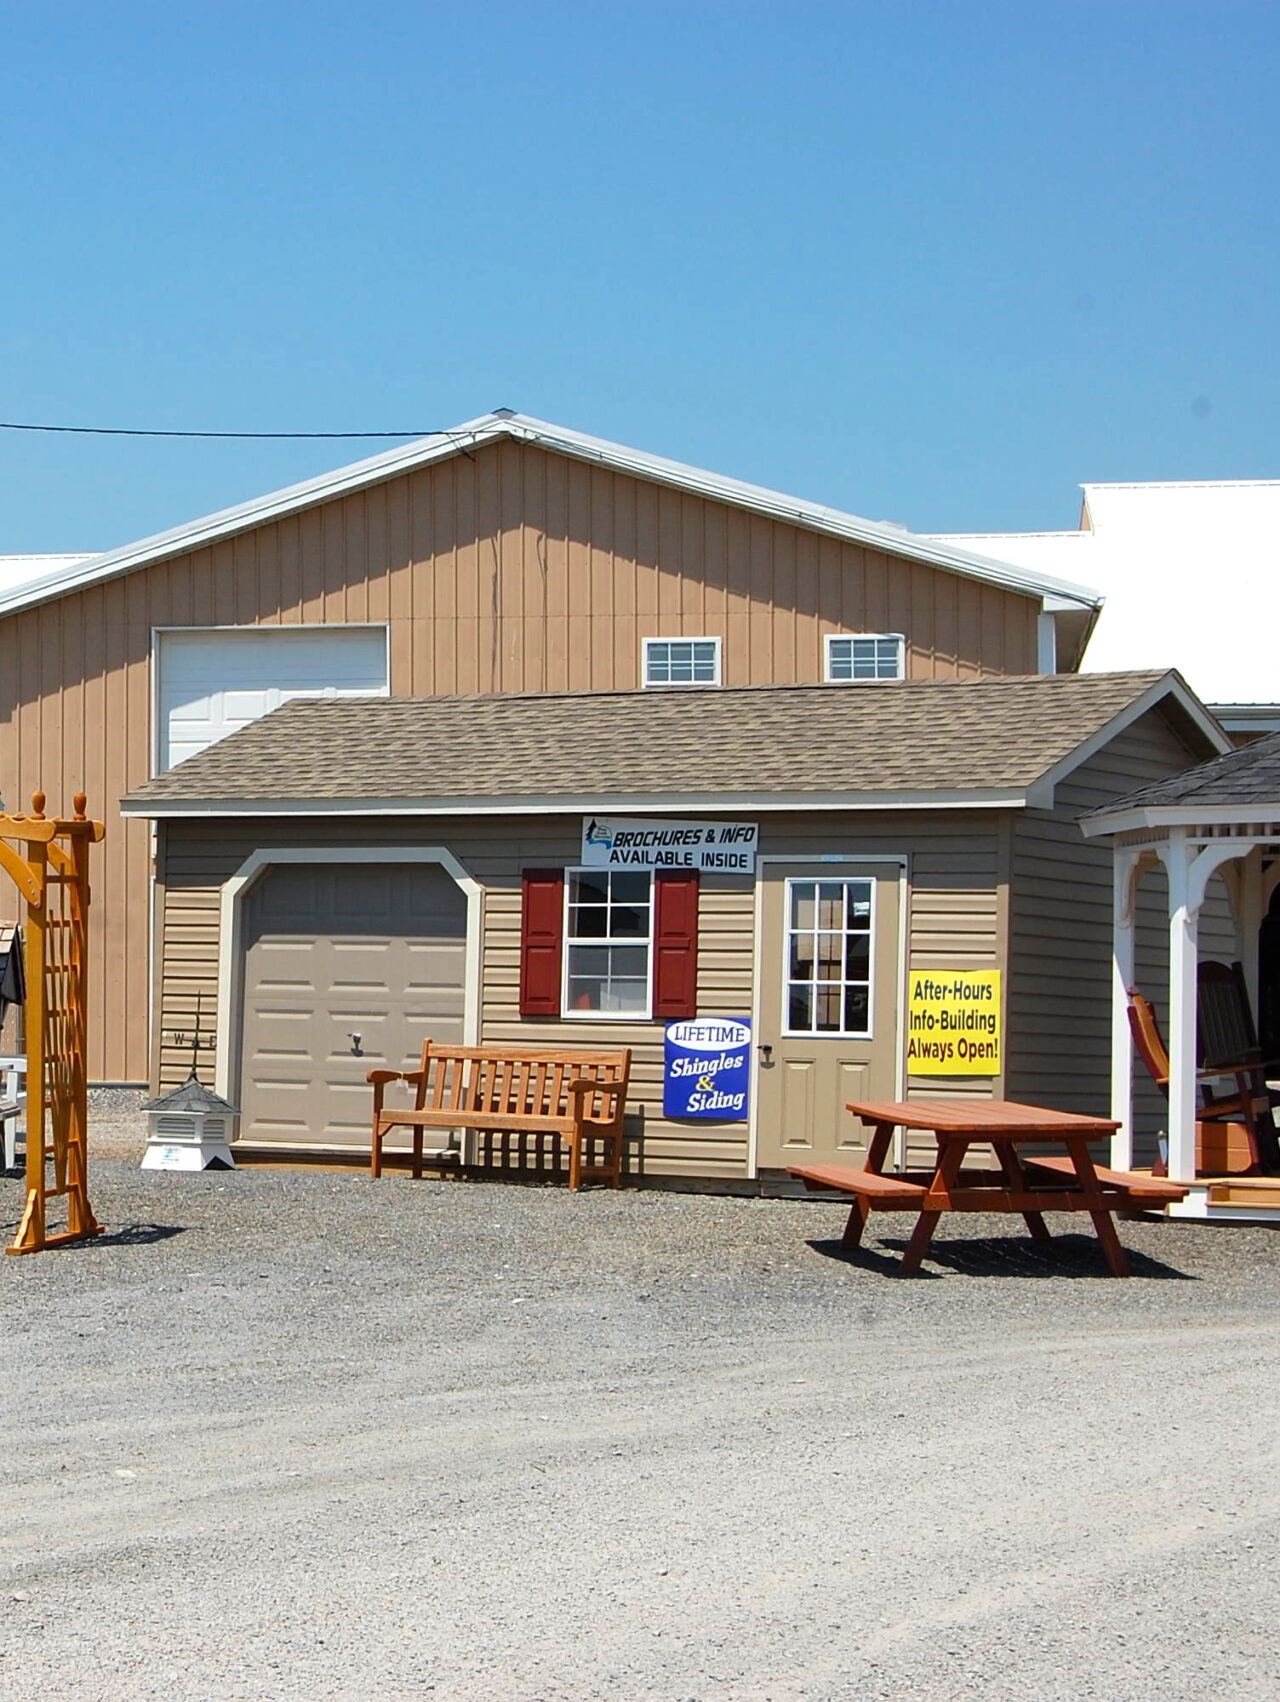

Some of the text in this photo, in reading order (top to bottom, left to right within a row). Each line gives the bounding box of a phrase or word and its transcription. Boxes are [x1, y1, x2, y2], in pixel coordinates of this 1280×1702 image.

[613, 829, 703, 848] BROCHURES
[705, 829, 716, 844] &
[719, 826, 756, 844] INFO
[609, 850, 748, 868] AVAILABLE INSIDE
[913, 979, 992, 1000] After-Hours
[910, 1009, 996, 1034] Info-Building
[674, 1026, 745, 1042] LIFETIME
[907, 1037, 998, 1062] Always Open!
[670, 1052, 744, 1077] Shingles
[696, 1075, 715, 1091] &
[686, 1091, 745, 1112] Siding
